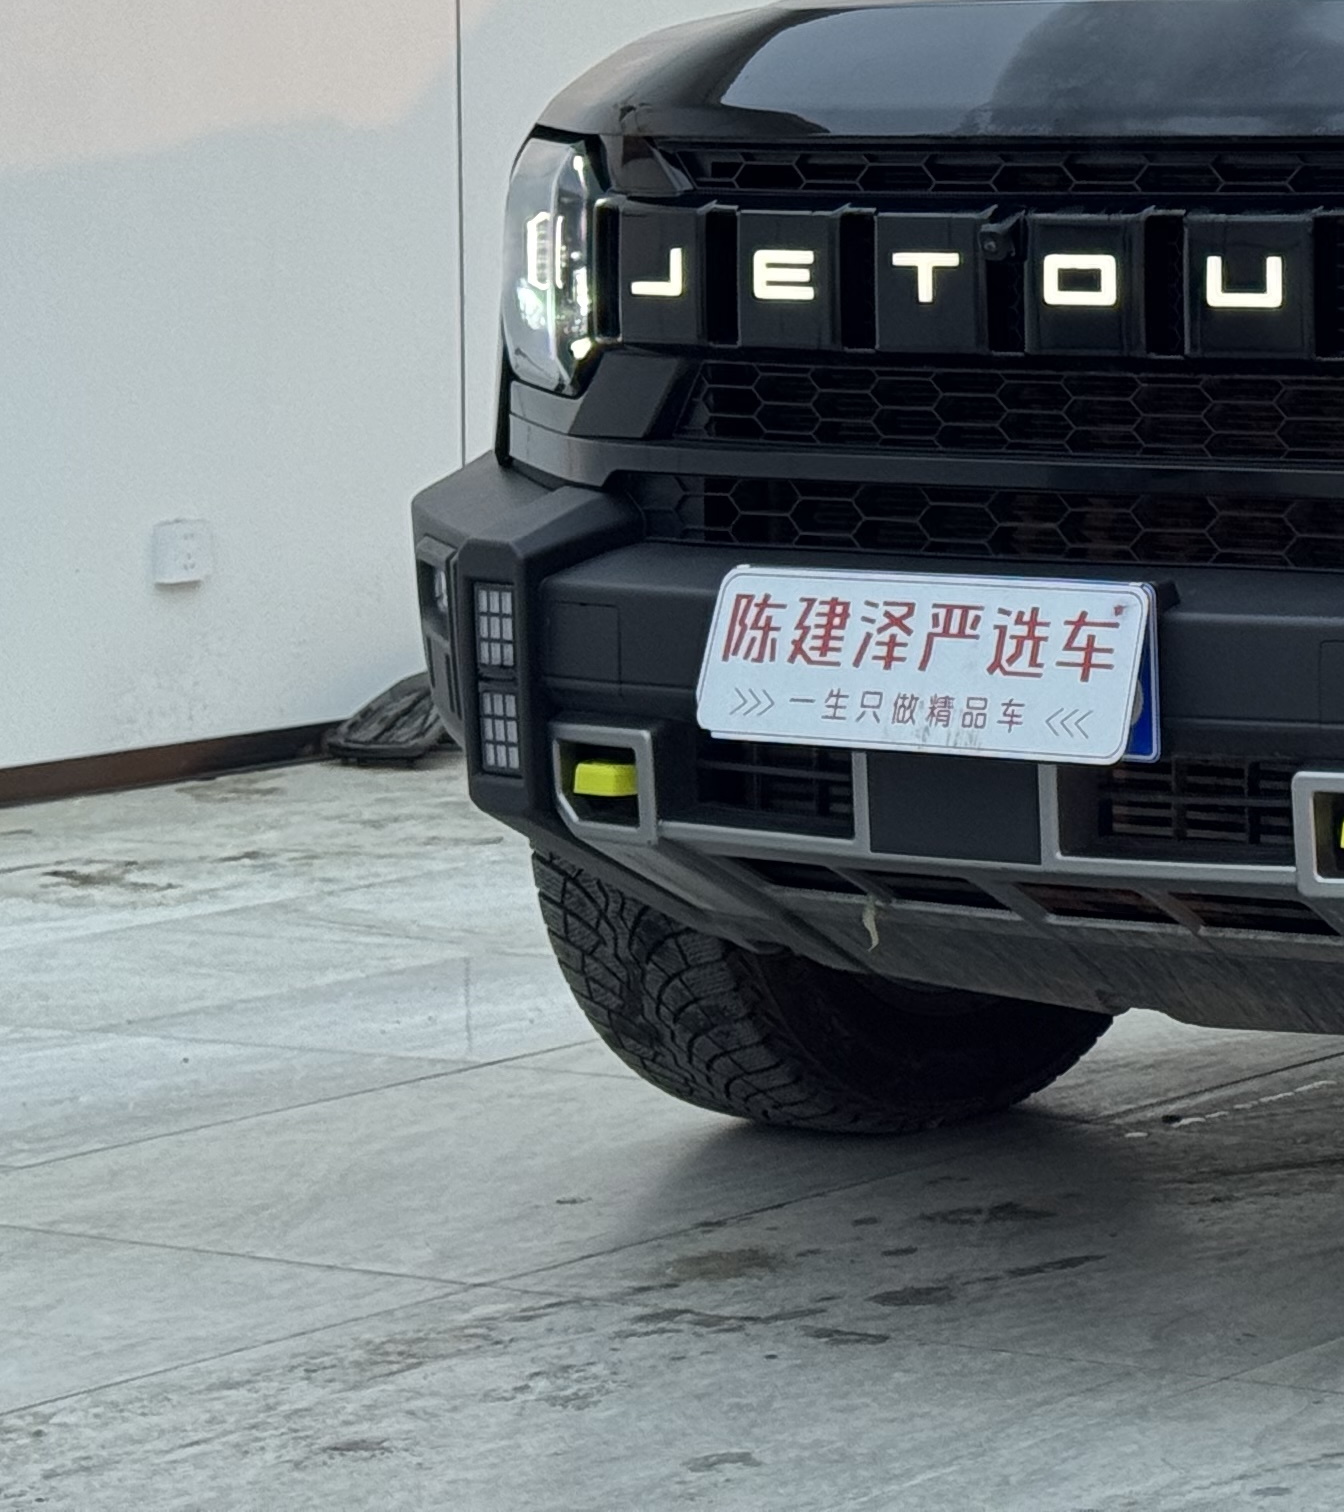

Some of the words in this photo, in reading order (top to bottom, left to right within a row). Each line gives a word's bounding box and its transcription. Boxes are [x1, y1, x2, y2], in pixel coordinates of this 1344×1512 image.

[721, 593, 1121, 682] 陈建泽严选车
[789, 689, 1025, 732] 一生只做精品车
